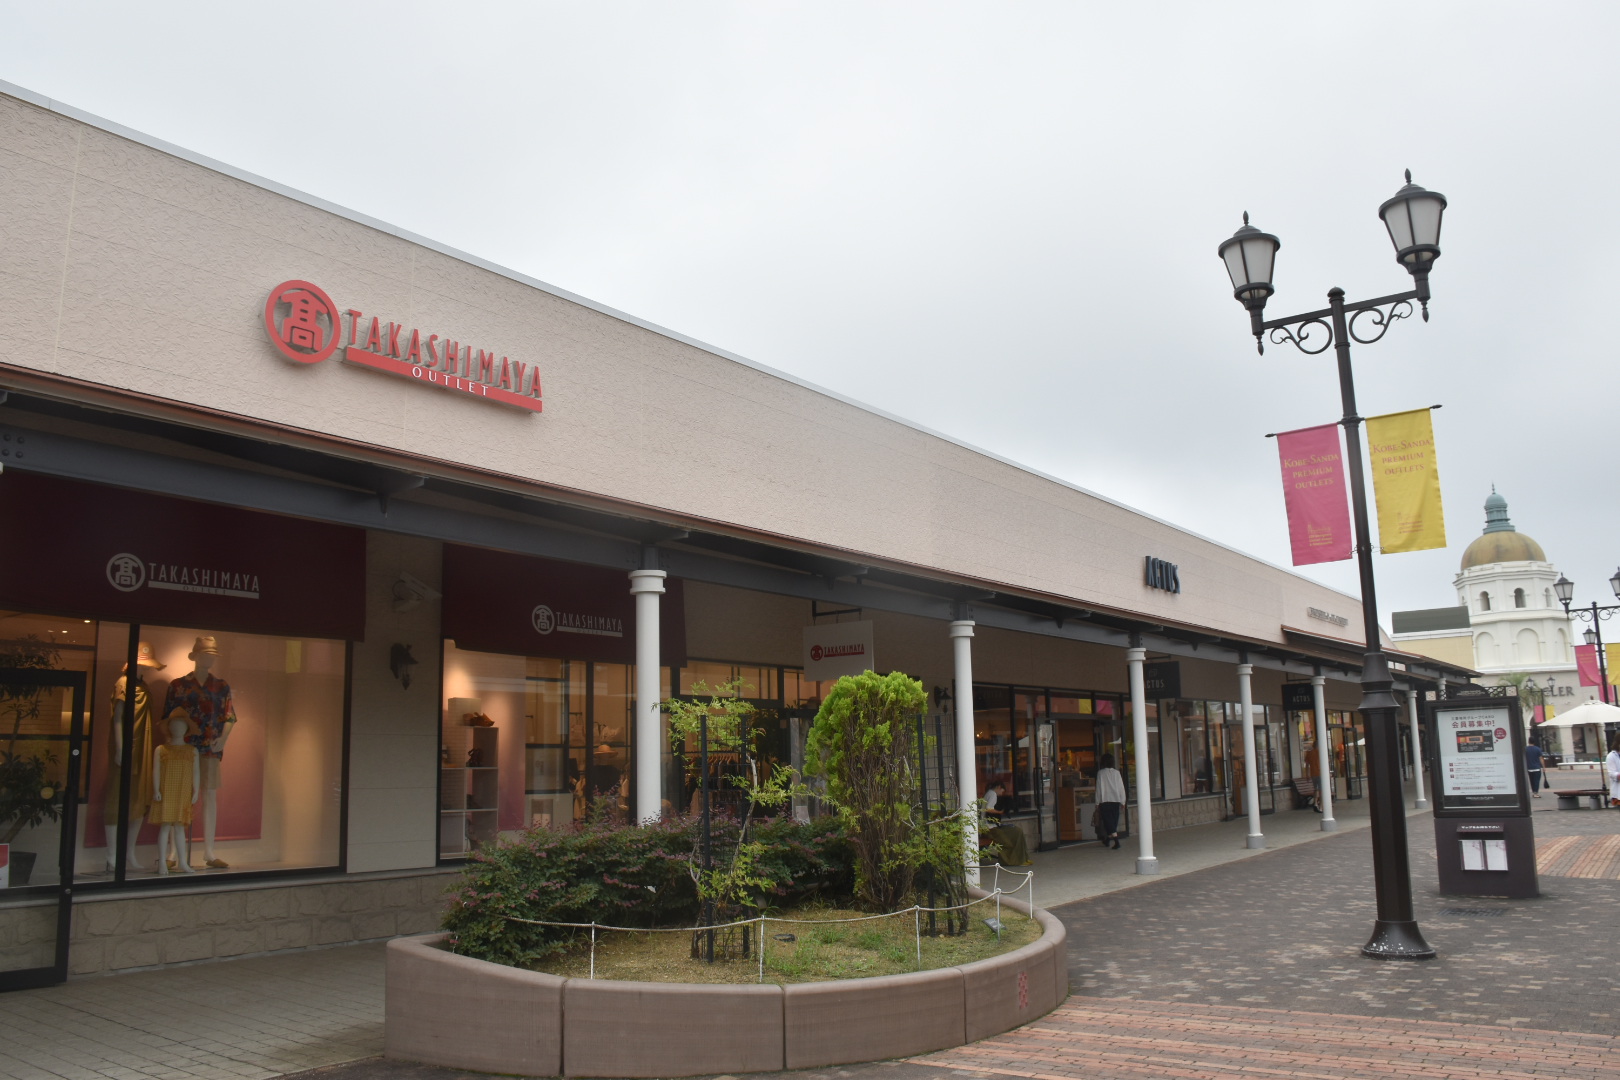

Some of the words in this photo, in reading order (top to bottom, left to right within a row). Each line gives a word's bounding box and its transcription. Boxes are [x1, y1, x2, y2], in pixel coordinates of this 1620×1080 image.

[347, 308, 543, 398] TAKASHIMAYA
[412, 366, 489, 396] OUTLET
[1382, 452, 1424, 464] PREMIUM
[1292, 466, 1333, 478] PREMIUM
[1384, 464, 1425, 475] OUTLETS
[1295, 478, 1334, 489] OUTLETS
[148, 562, 260, 592] TAKASHIMAYA
[1145, 556, 1180, 594] ACTUS
[183, 585, 227, 595] OUTLET
[556, 611, 623, 632] TAKASHIMAYA
[824, 643, 864, 655] TAKASHIMAYA
